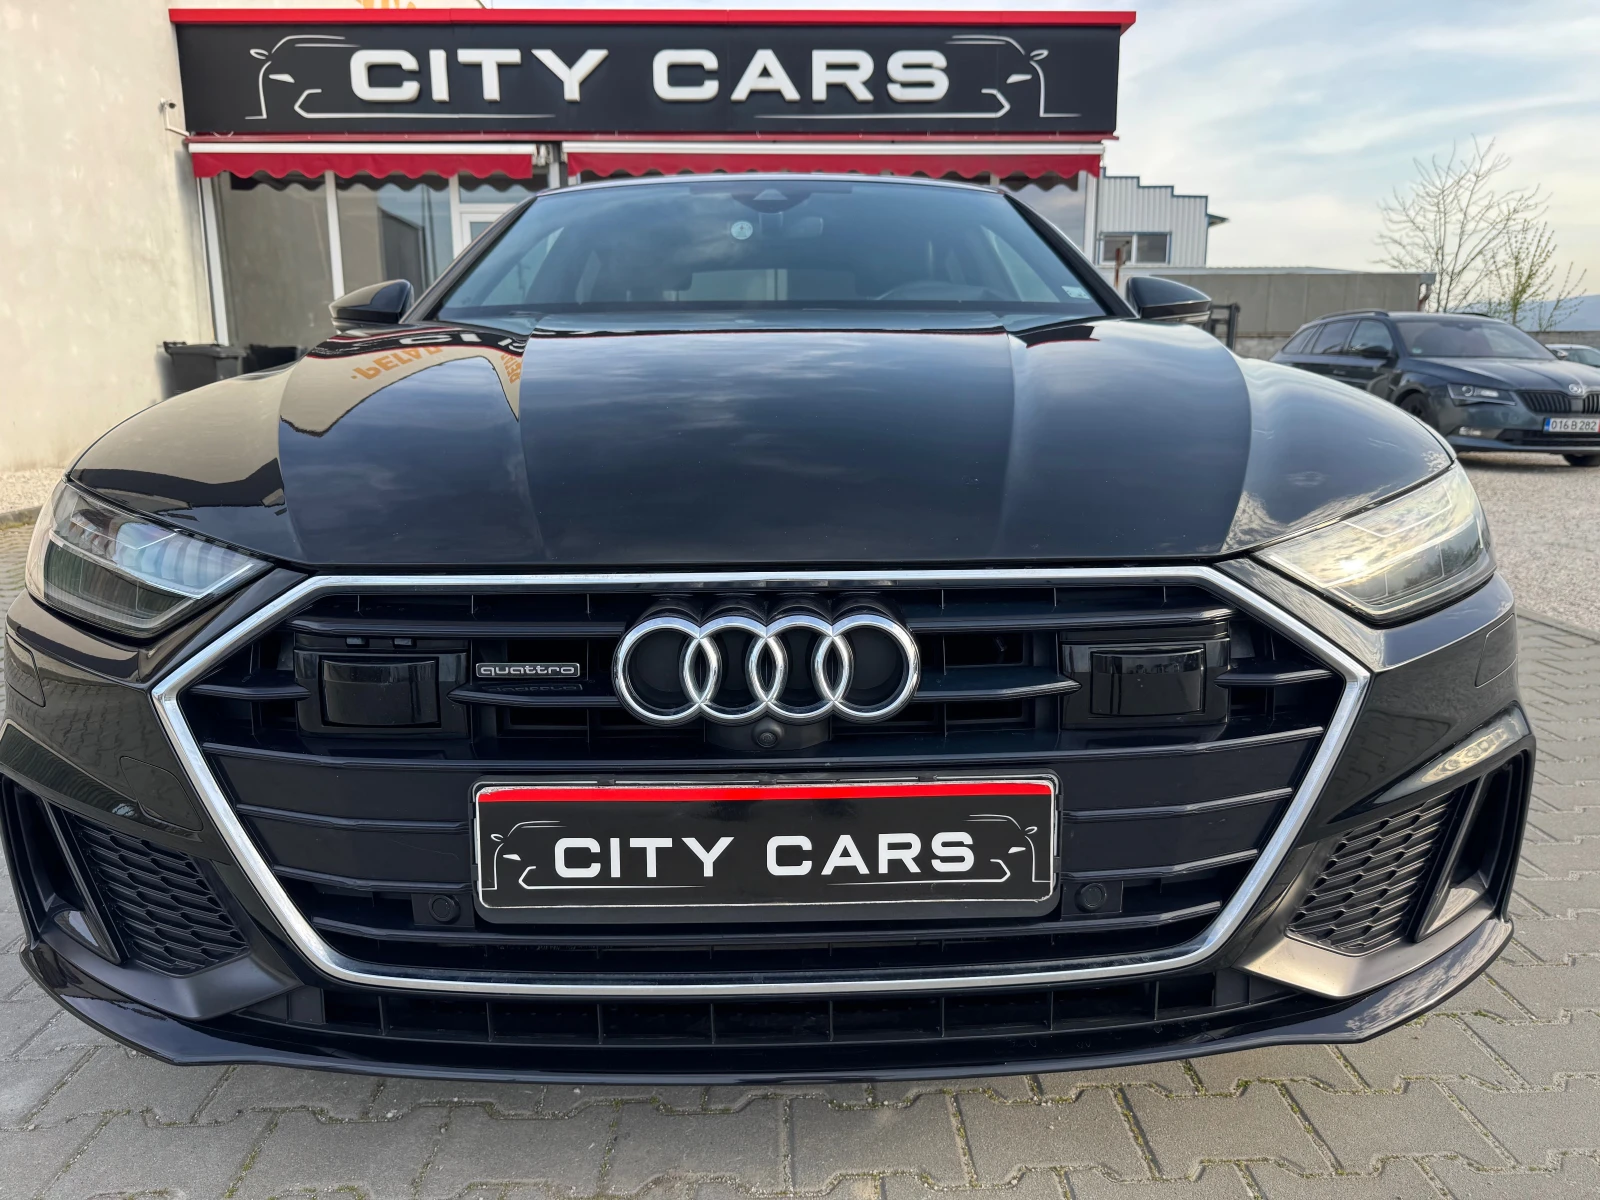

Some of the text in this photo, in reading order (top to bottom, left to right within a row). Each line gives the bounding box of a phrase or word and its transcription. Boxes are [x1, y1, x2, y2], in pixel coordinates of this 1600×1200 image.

[349, 48, 950, 103] CITY CARS
[480, 665, 575, 676] quattro
[554, 832, 974, 878] CITY CARS
